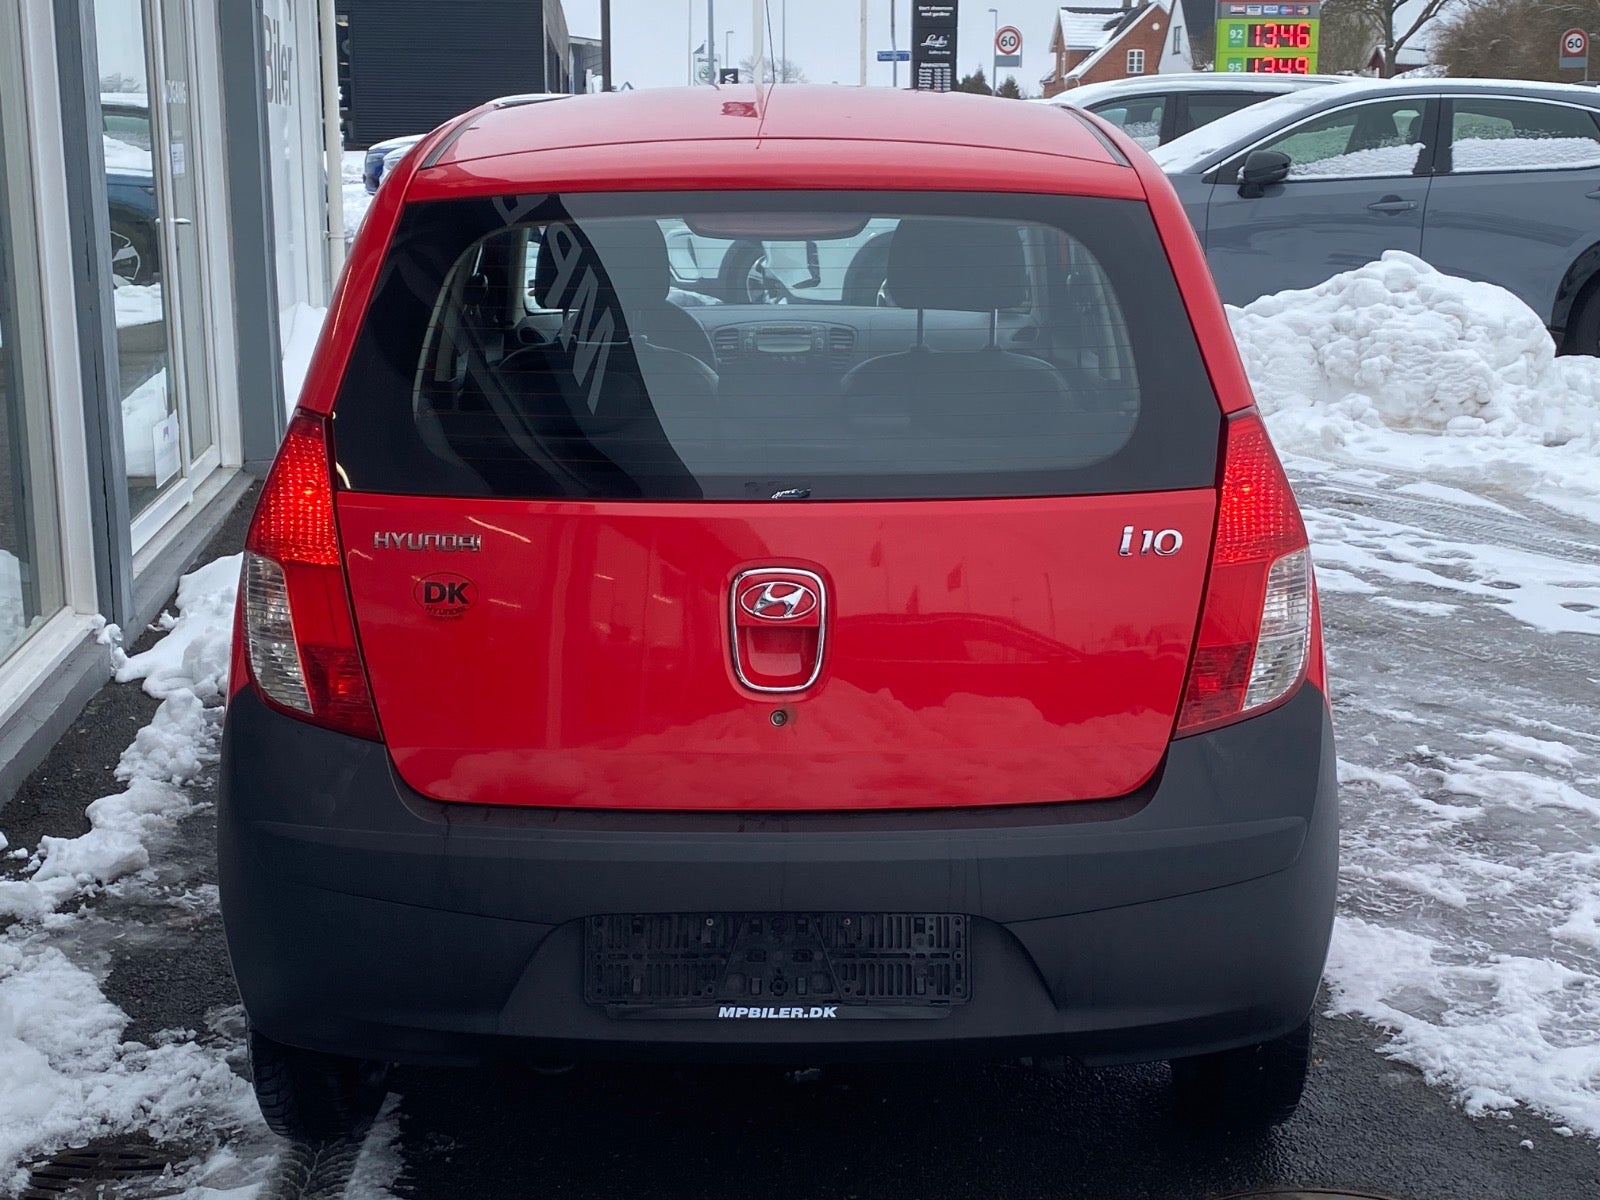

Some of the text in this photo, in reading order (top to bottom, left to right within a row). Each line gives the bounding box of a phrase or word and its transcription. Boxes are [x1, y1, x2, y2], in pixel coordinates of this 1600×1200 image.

[1229, 29, 1243, 39] 92
[1000, 35, 1016, 47] 60
[1567, 38, 1583, 49] 60
[263, 14, 292, 106] Biler
[1228, 63, 1242, 72] 95
[373, 530, 482, 551] HYUNDAI
[423, 581, 470, 605] DK
[718, 1006, 838, 1019] MPBILER.DK
